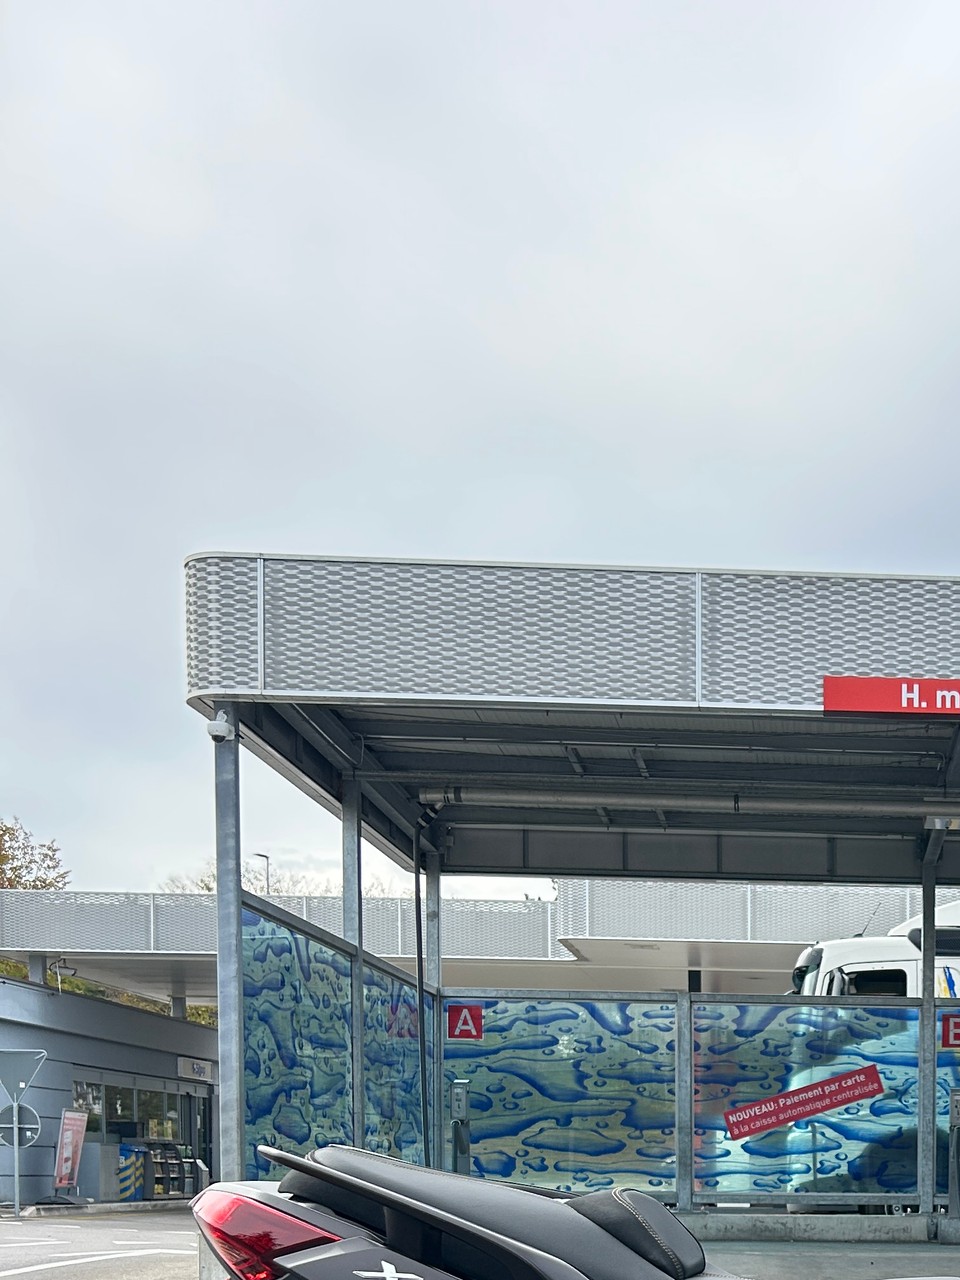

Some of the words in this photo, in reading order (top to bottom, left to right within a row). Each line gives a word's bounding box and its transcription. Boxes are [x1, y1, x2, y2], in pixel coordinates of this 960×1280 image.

[901, 683, 927, 708] H.
[454, 1008, 477, 1036] A
[728, 1102, 778, 1124] NOUVEAU:
[779, 1087, 823, 1107] Paiement
[824, 1083, 839, 1096] par
[842, 1073, 866, 1088] carte
[740, 1124, 749, 1132] la
[750, 1116, 777, 1130] caisse
[779, 1098, 831, 1121] automatique
[832, 1082, 879, 1103] centralisée
